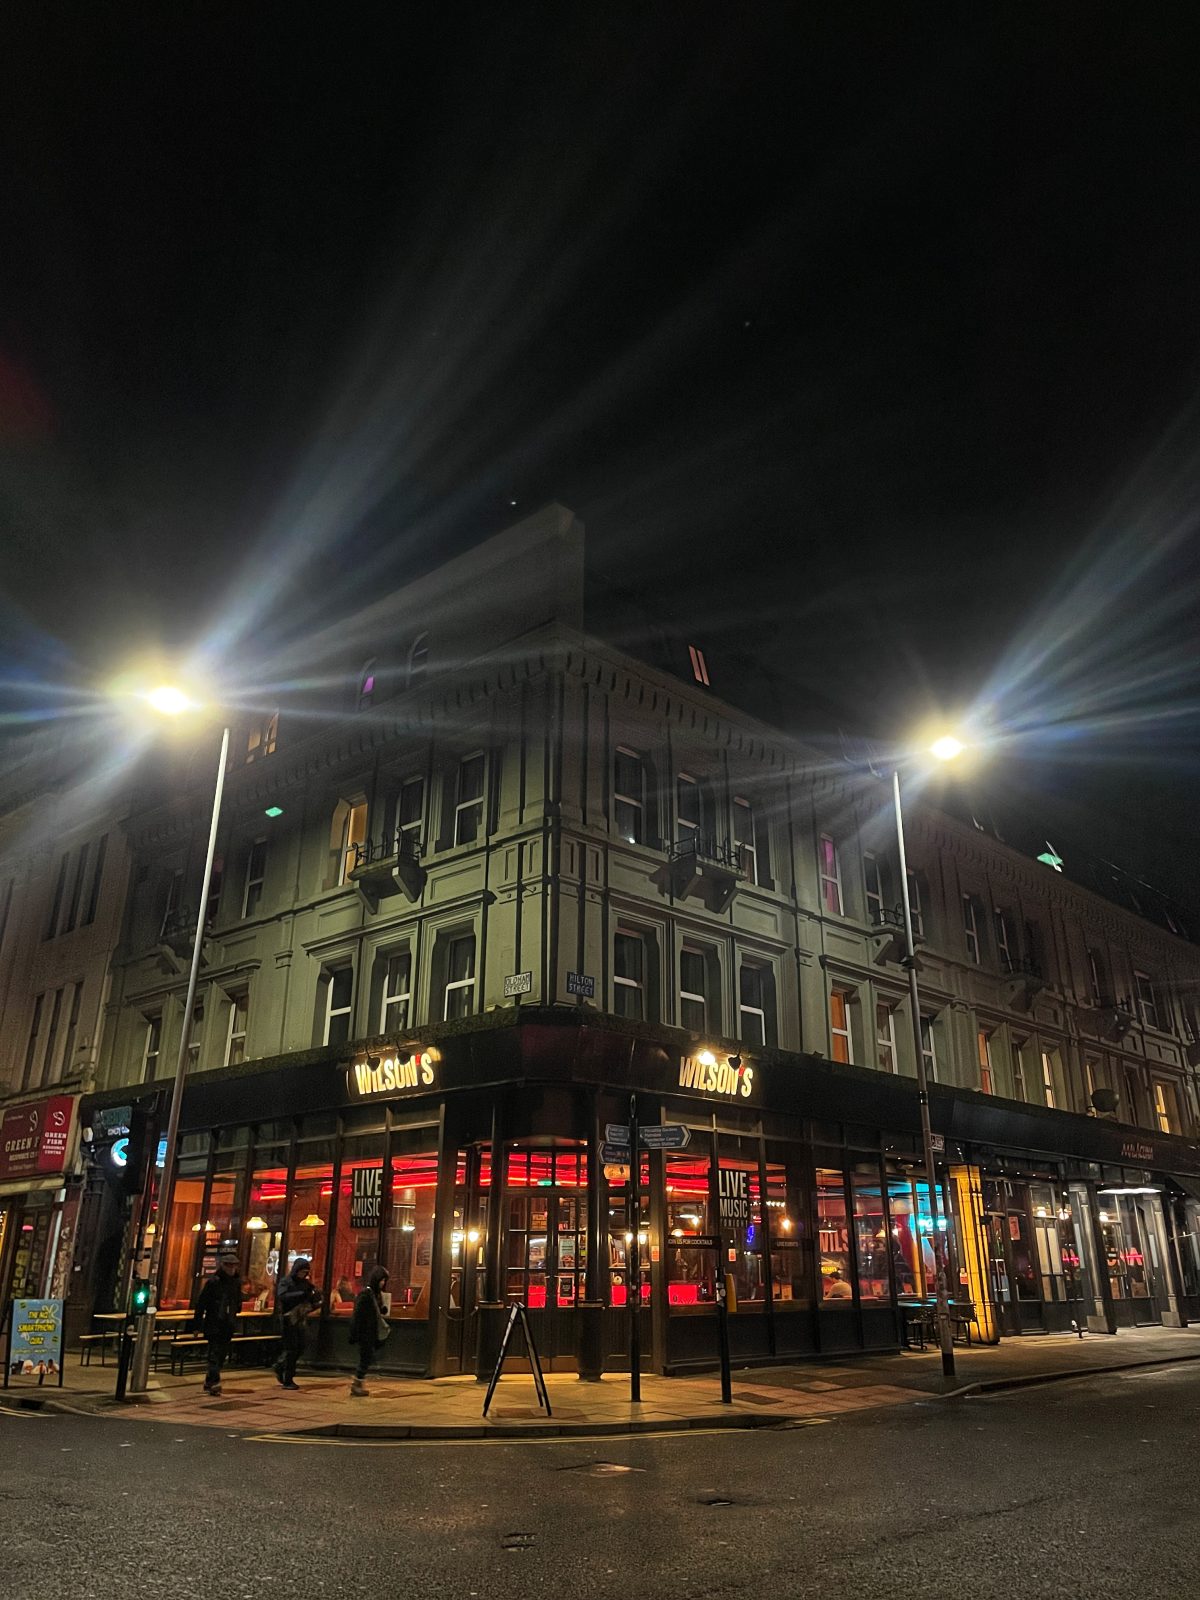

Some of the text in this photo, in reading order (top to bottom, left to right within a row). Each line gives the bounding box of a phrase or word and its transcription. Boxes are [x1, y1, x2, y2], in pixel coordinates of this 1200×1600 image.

[505, 983, 530, 995] STREET
[506, 973, 531, 987] OLDHAM
[568, 983, 593, 996] STREET
[569, 973, 593, 986] HILTON
[355, 1053, 434, 1096] WILSON'S
[678, 1054, 753, 1098] WILSON'S
[5, 1137, 33, 1153] GREEN
[354, 1168, 384, 1197] LIVE
[718, 1169, 748, 1199] LIVE
[353, 1197, 382, 1217] MUSIC
[719, 1198, 748, 1218] MUSIC
